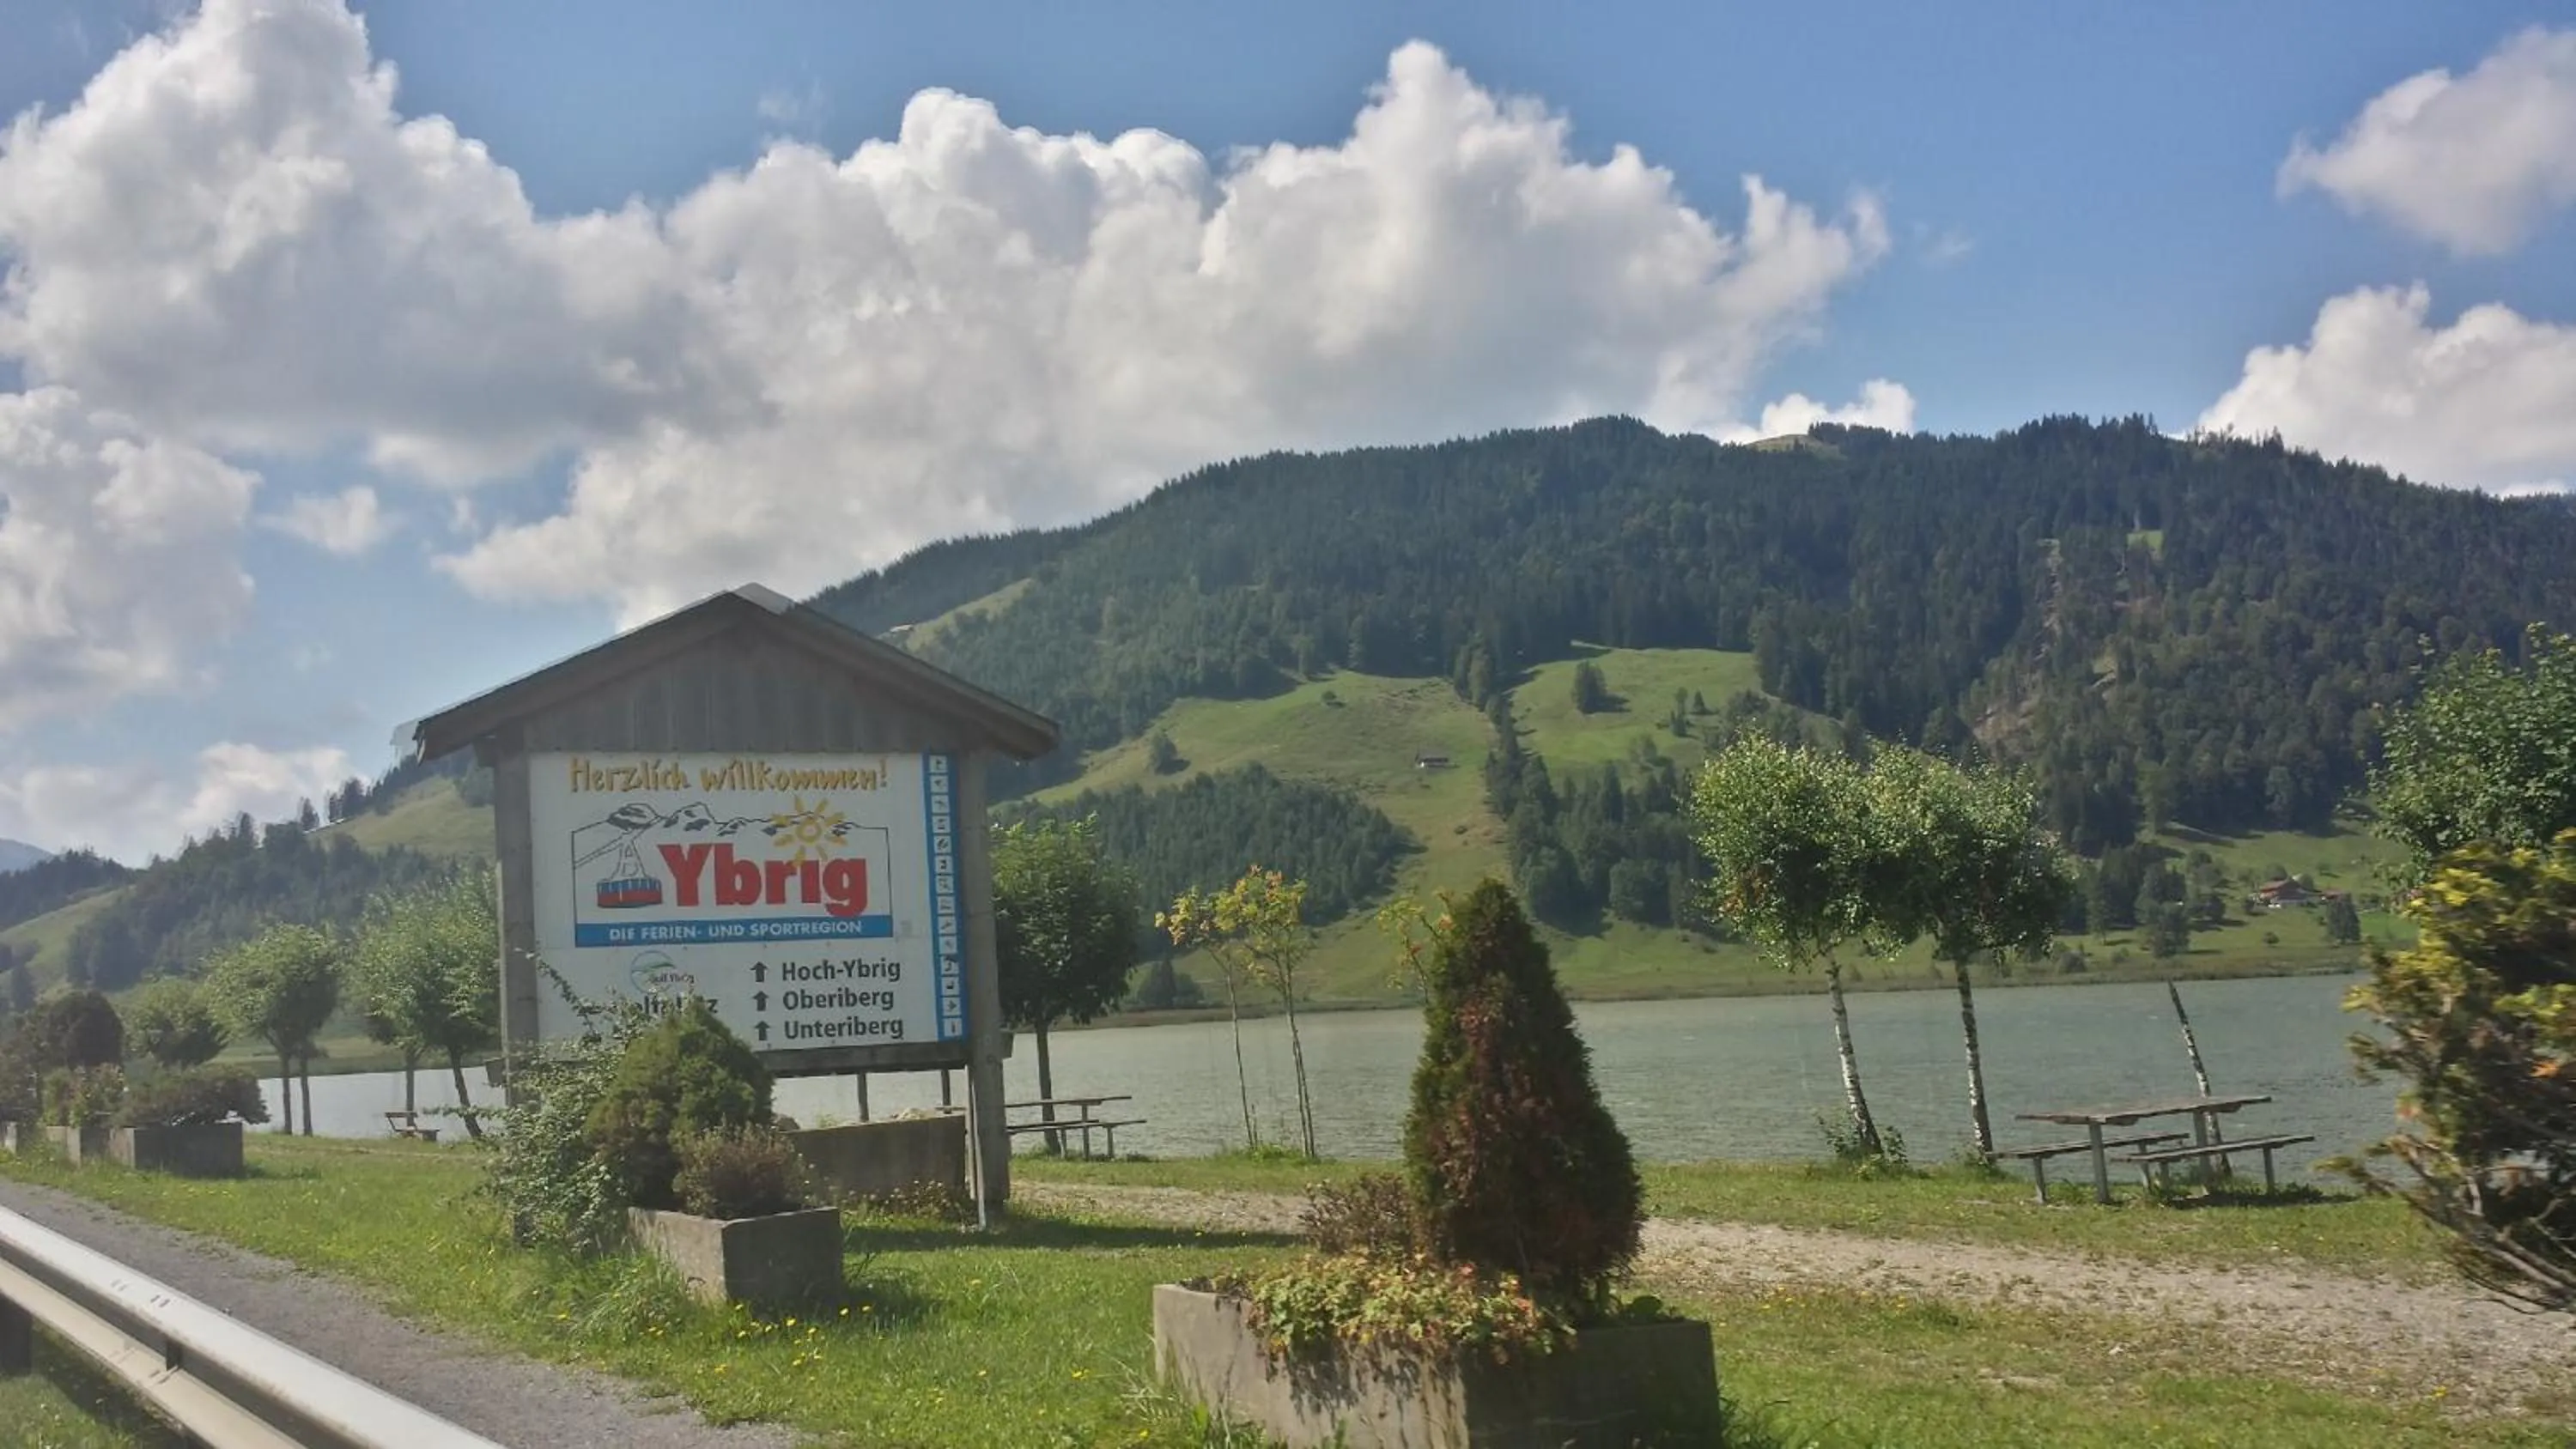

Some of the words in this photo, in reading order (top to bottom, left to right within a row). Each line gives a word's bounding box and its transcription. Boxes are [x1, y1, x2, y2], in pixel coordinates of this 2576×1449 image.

[570, 757, 692, 793] Herzlich
[699, 755, 888, 792] willkommen!
[657, 842, 869, 919] Ybrig
[609, 927, 635, 942] DIE
[641, 924, 702, 941] FERIEN-
[708, 922, 745, 938] UND
[749, 919, 863, 937] SPORTREGION
[781, 957, 902, 983] Hoch-Ybrig
[782, 986, 895, 1011] Oberiberg
[783, 1015, 904, 1040] Unteriberg
